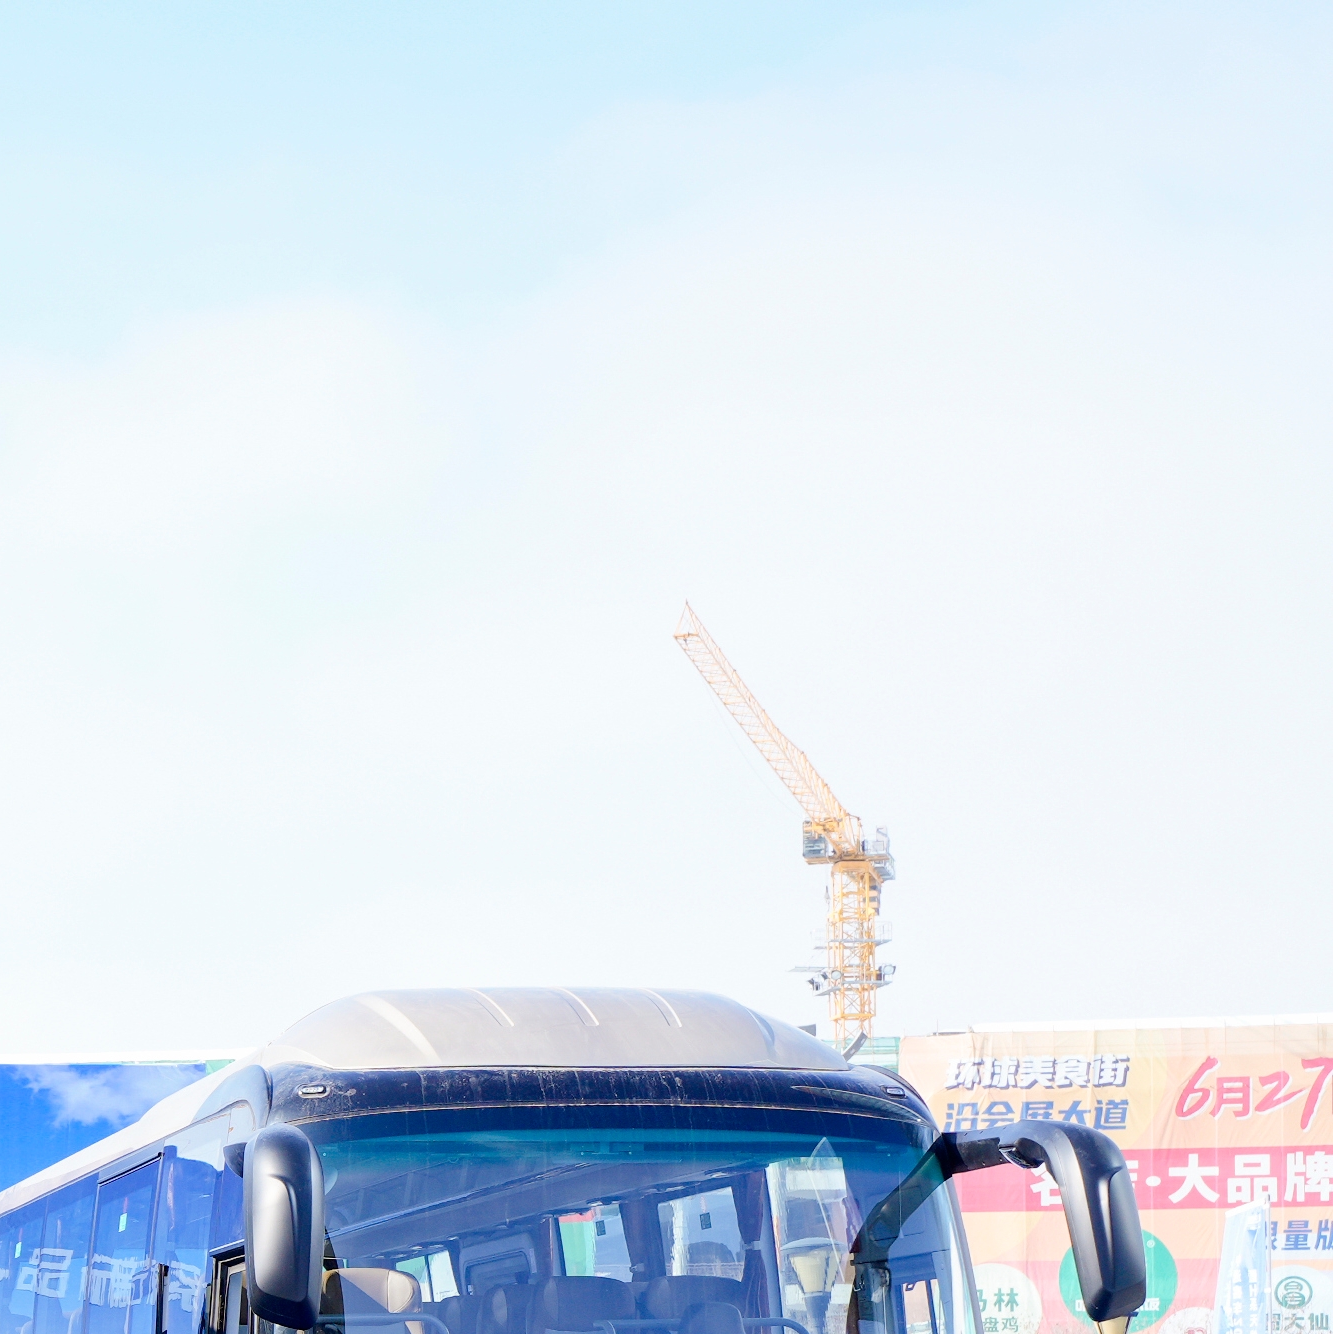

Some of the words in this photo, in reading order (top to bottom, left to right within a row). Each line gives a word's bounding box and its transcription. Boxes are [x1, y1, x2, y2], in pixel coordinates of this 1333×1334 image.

[944, 1054, 1130, 1091] 环球美食街
[943, 1099, 1129, 1132] 沿会展大道
